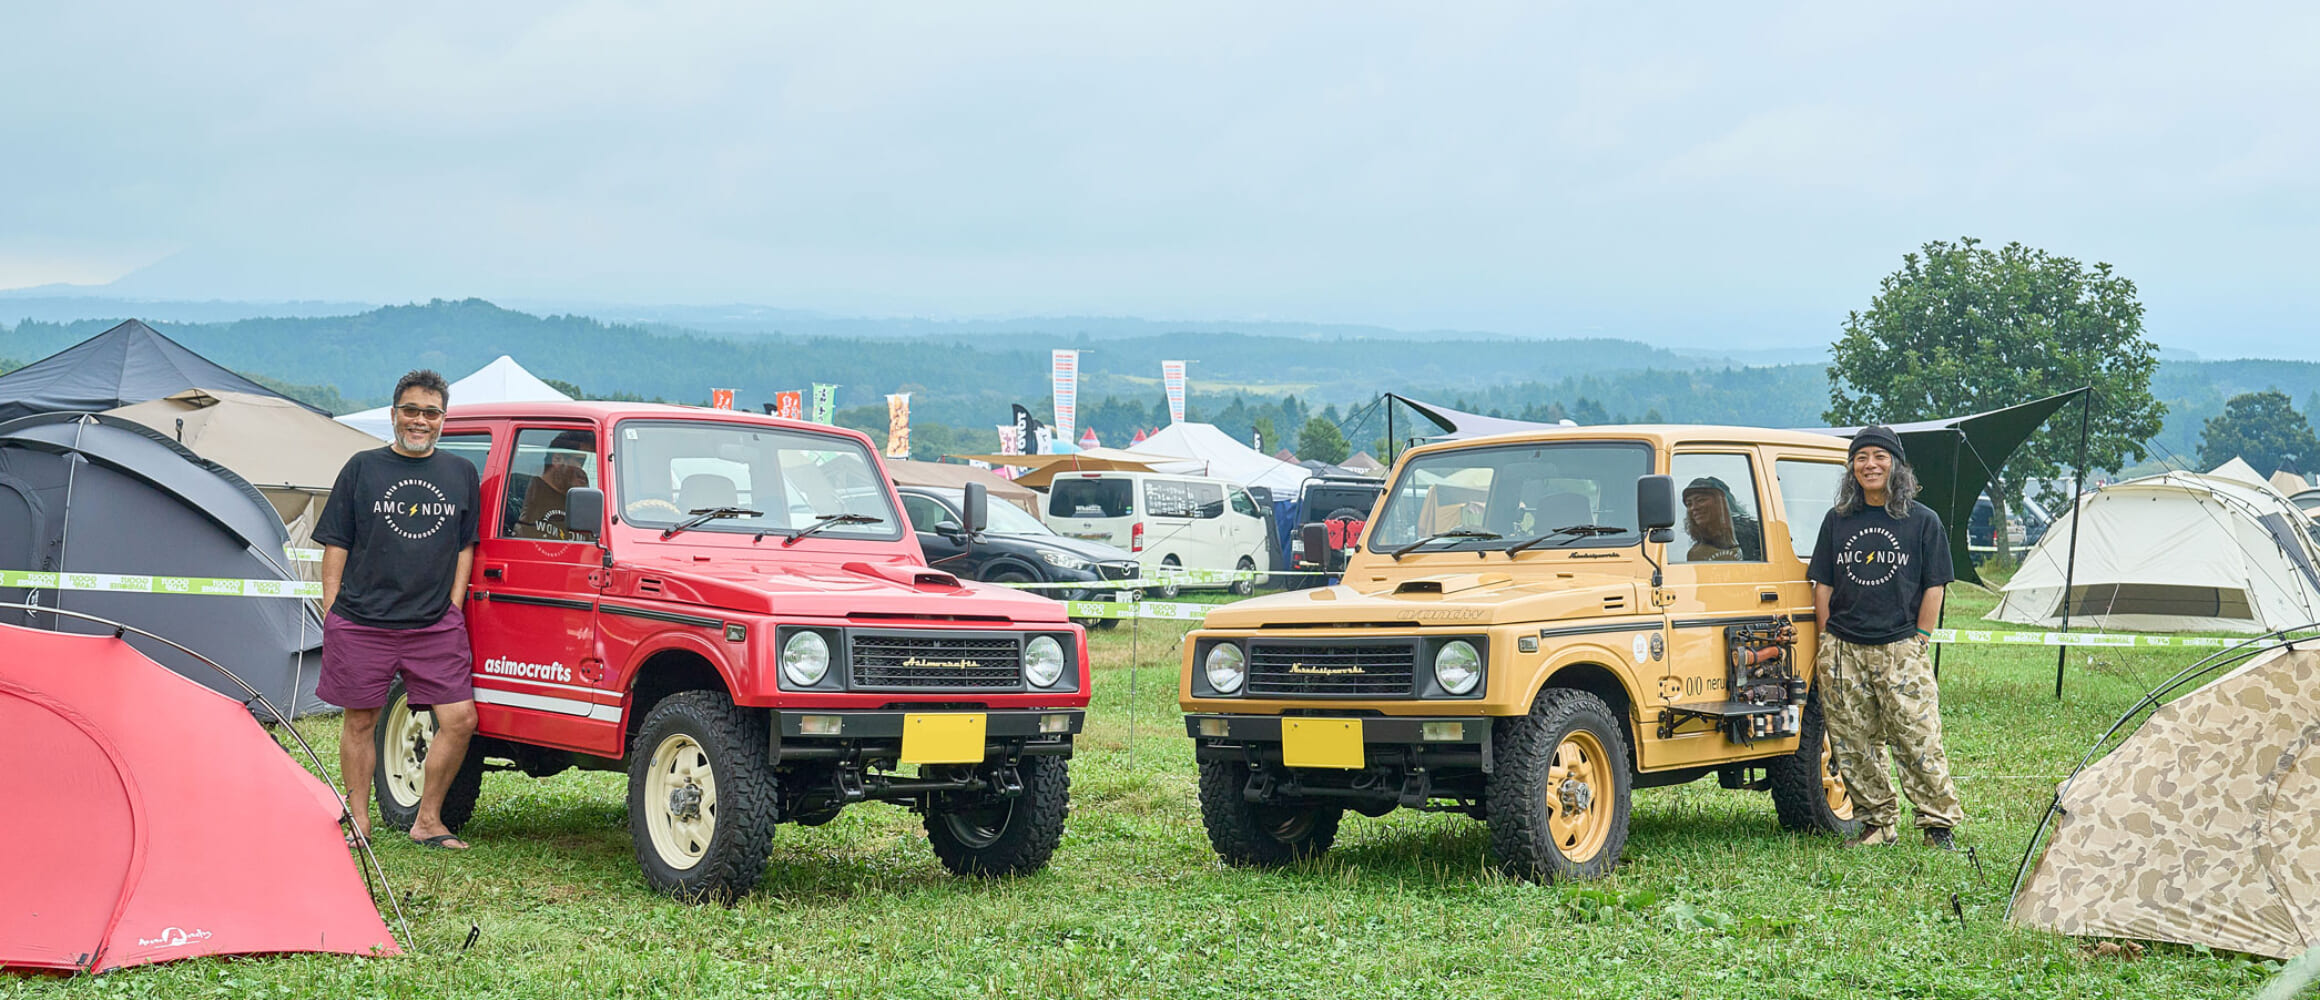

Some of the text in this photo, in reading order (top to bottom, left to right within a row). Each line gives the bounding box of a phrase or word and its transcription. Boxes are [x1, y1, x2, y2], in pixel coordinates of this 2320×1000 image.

[373, 500, 456, 516] AMC NDW
[1836, 550, 1910, 566] AMC NDW
[484, 655, 572, 682] asimocrafts
